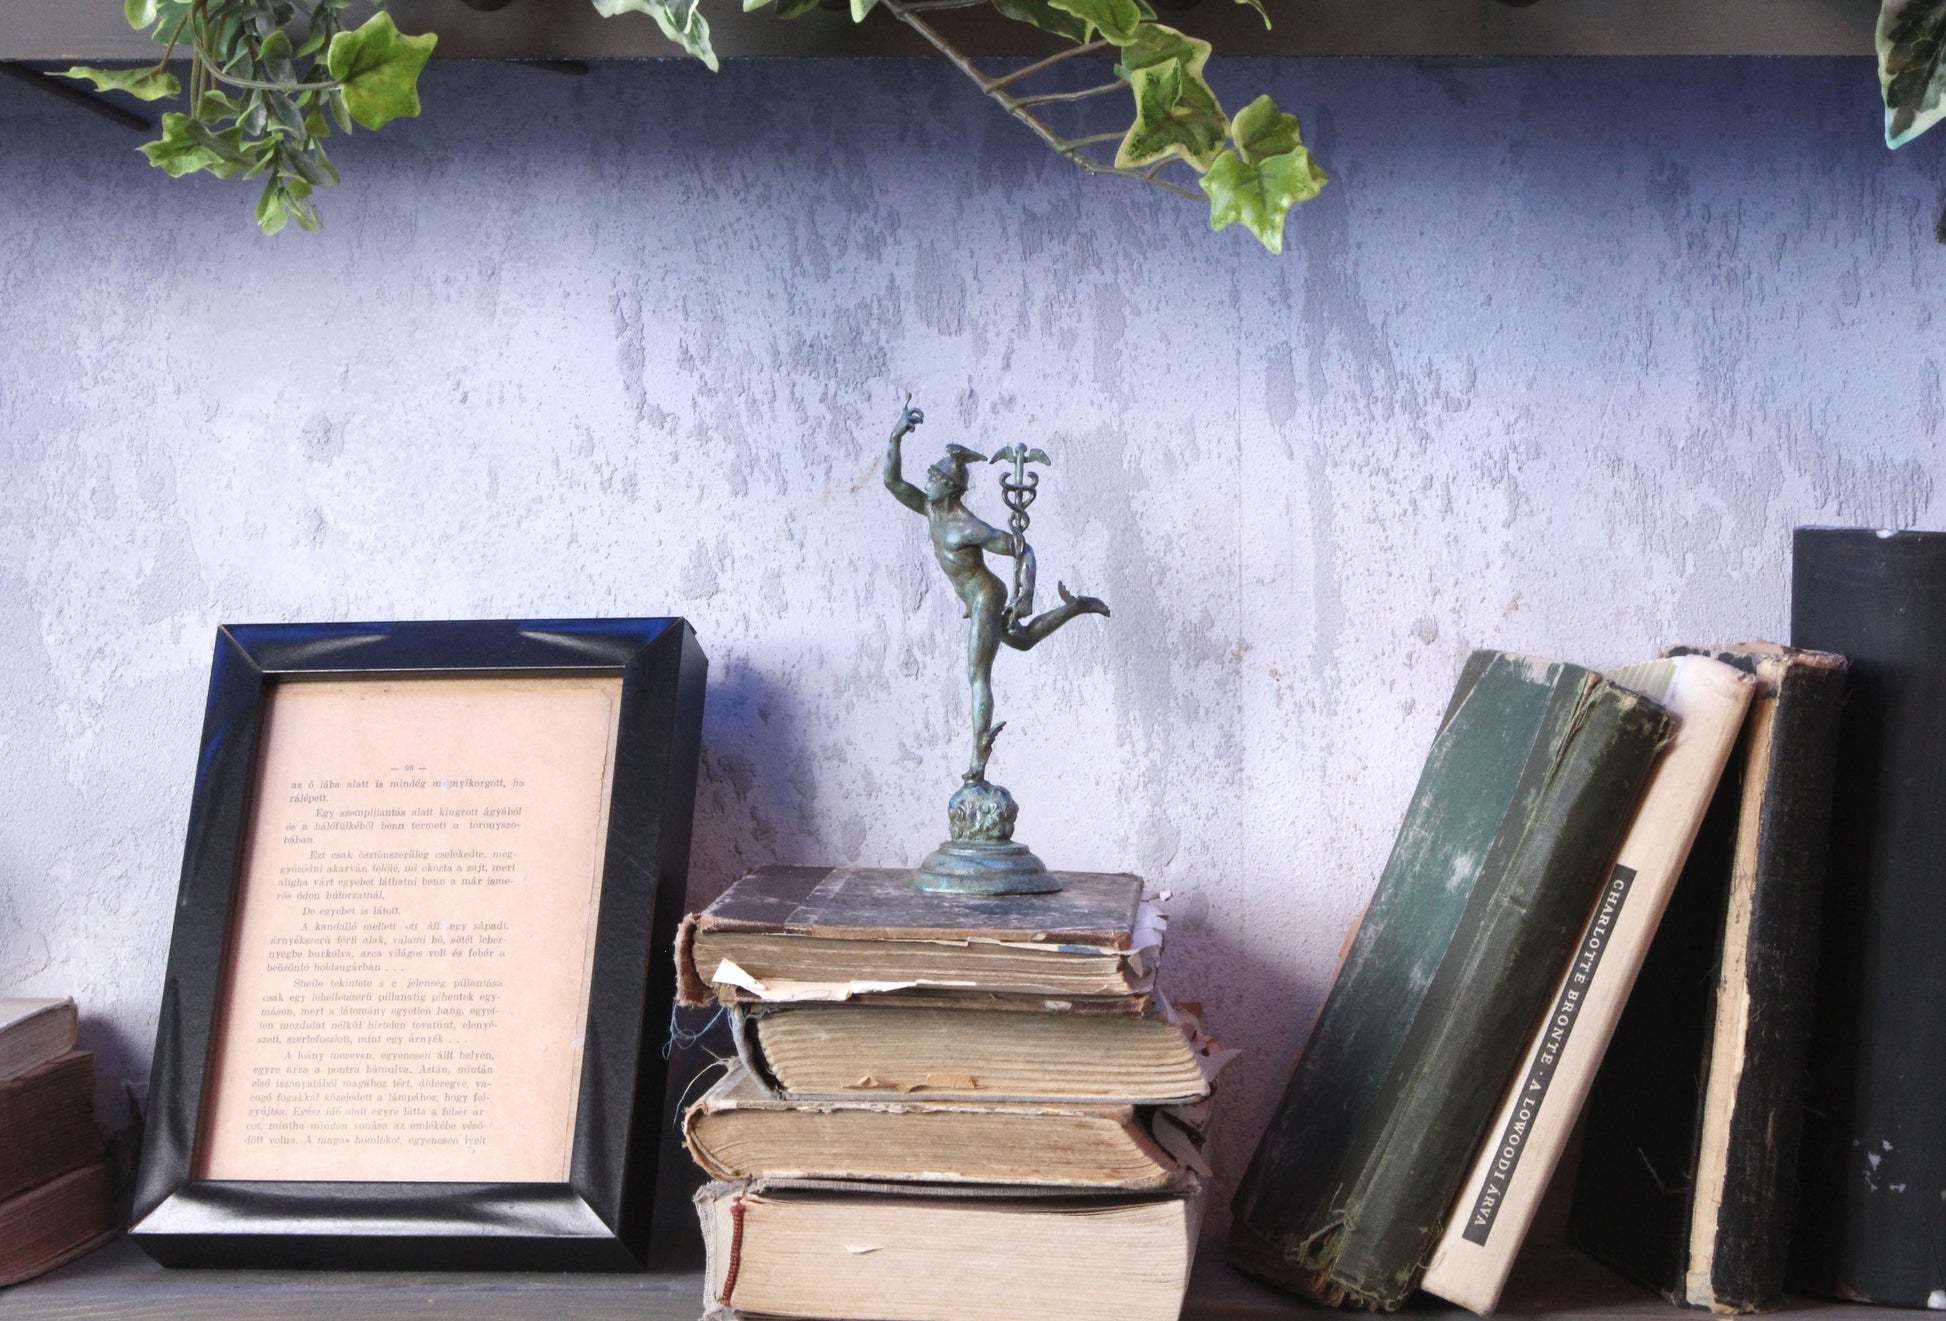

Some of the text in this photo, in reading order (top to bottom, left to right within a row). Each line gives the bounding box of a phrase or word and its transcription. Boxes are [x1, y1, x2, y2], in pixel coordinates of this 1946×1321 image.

[290, 781, 303, 790] az
[319, 779, 341, 790] lába
[346, 779, 369, 789] alatt
[375, 778, 385, 790] is
[512, 777, 525, 788] ha
[289, 793, 329, 805] rálépett.
[315, 807, 335, 819] Egy
[410, 807, 434, 817] alatt
[439, 806, 479, 818] kiugrott
[482, 806, 523, 818] ágyából
[380, 821, 405, 831] benn
[411, 821, 447, 831] termett
[469, 821, 521, 831] toronyszo-
[309, 850, 326, 861] Ezt
[330, 850, 353, 860] csak
[326, 863, 368, 873] akarván
[404, 863, 418, 873] mi
[421, 863, 453, 873] okozta
[491, 863, 516, 873] mert
[278, 877, 309, 889] aligha
[313, 877, 334, 887] várt
[337, 877, 374, 888] egyebet
[378, 876, 418, 887] láthatni
[421, 876, 446, 886] benn
[461, 876, 483, 886] már
[486, 877, 514, 887] isme-
[296, 890, 321, 901] ódon
[325, 889, 385, 900] bútorzatnál.
[301, 905, 401, 917] De egyebet is látott.
[314, 921, 358, 932] kandalló
[363, 921, 396, 931] mellett
[336, 935, 358, 945] férfi
[362, 934, 387, 946] alak,
[392, 935, 427, 945] valami
[450, 934, 474, 945] sötét
[307, 948, 355, 959] burkolva,
[360, 950, 383, 958] arca
[388, 948, 423, 960] világos
[428, 948, 447, 958] volt
[451, 948, 463, 958] és
[467, 947, 495, 958] fehér
[313, 962, 381, 973] holdsugárban
[330, 978, 373, 988] tekintete
[406, 977, 446, 989] jelenség
[262, 991, 501, 1004] csak egy pillanatig pihentek egy-
[300, 1007, 324, 1016] mert
[340, 1005, 386, 1017] látomány
[390, 1006, 432, 1017] egyetlen
[258, 1020, 274, 1030] len
[330, 1020, 362, 1030] nélkül
[367, 1019, 406, 1030] hirtelen
[256, 1033, 444, 1046] szett, szertefoszlott, mint egy árnyék
[297, 1050, 324, 1062] leány
[330, 1052, 375, 1061] mereven,
[436, 1049, 454, 1061] állt
[459, 1049, 495, 1062] helyén,
[1473, 879, 1624, 1226] CHARLOTTE BRONTE A LOWOODI ÁRVA
[252, 1066, 281, 1075] egyre
[285, 1066, 309, 1074] arra
[327, 1065, 360, 1076] pontra
[365, 1064, 413, 1075] bámulva.
[418, 1064, 451, 1075] Aztán,
[456, 1064, 494, 1075] miután
[392, 1078, 413, 1089] tért,
[249, 1092, 272, 1103] cogó
[276, 1092, 320, 1103] fogakkal
[324, 1092, 373, 1102] közeledett
[444, 1092, 468, 1104] hogy
[345, 1106, 368, 1116] alatt
[371, 1108, 400, 1117] egyre
[403, 1106, 426, 1117] látta
[442, 1106, 468, 1117] fehér
[268, 1120, 305, 1131] mintha
[310, 1121, 348, 1130] minden
[393, 1122, 406, 1130] az
[410, 1120, 457, 1131] emlékébe
[317, 1137, 350, 1146] magas
